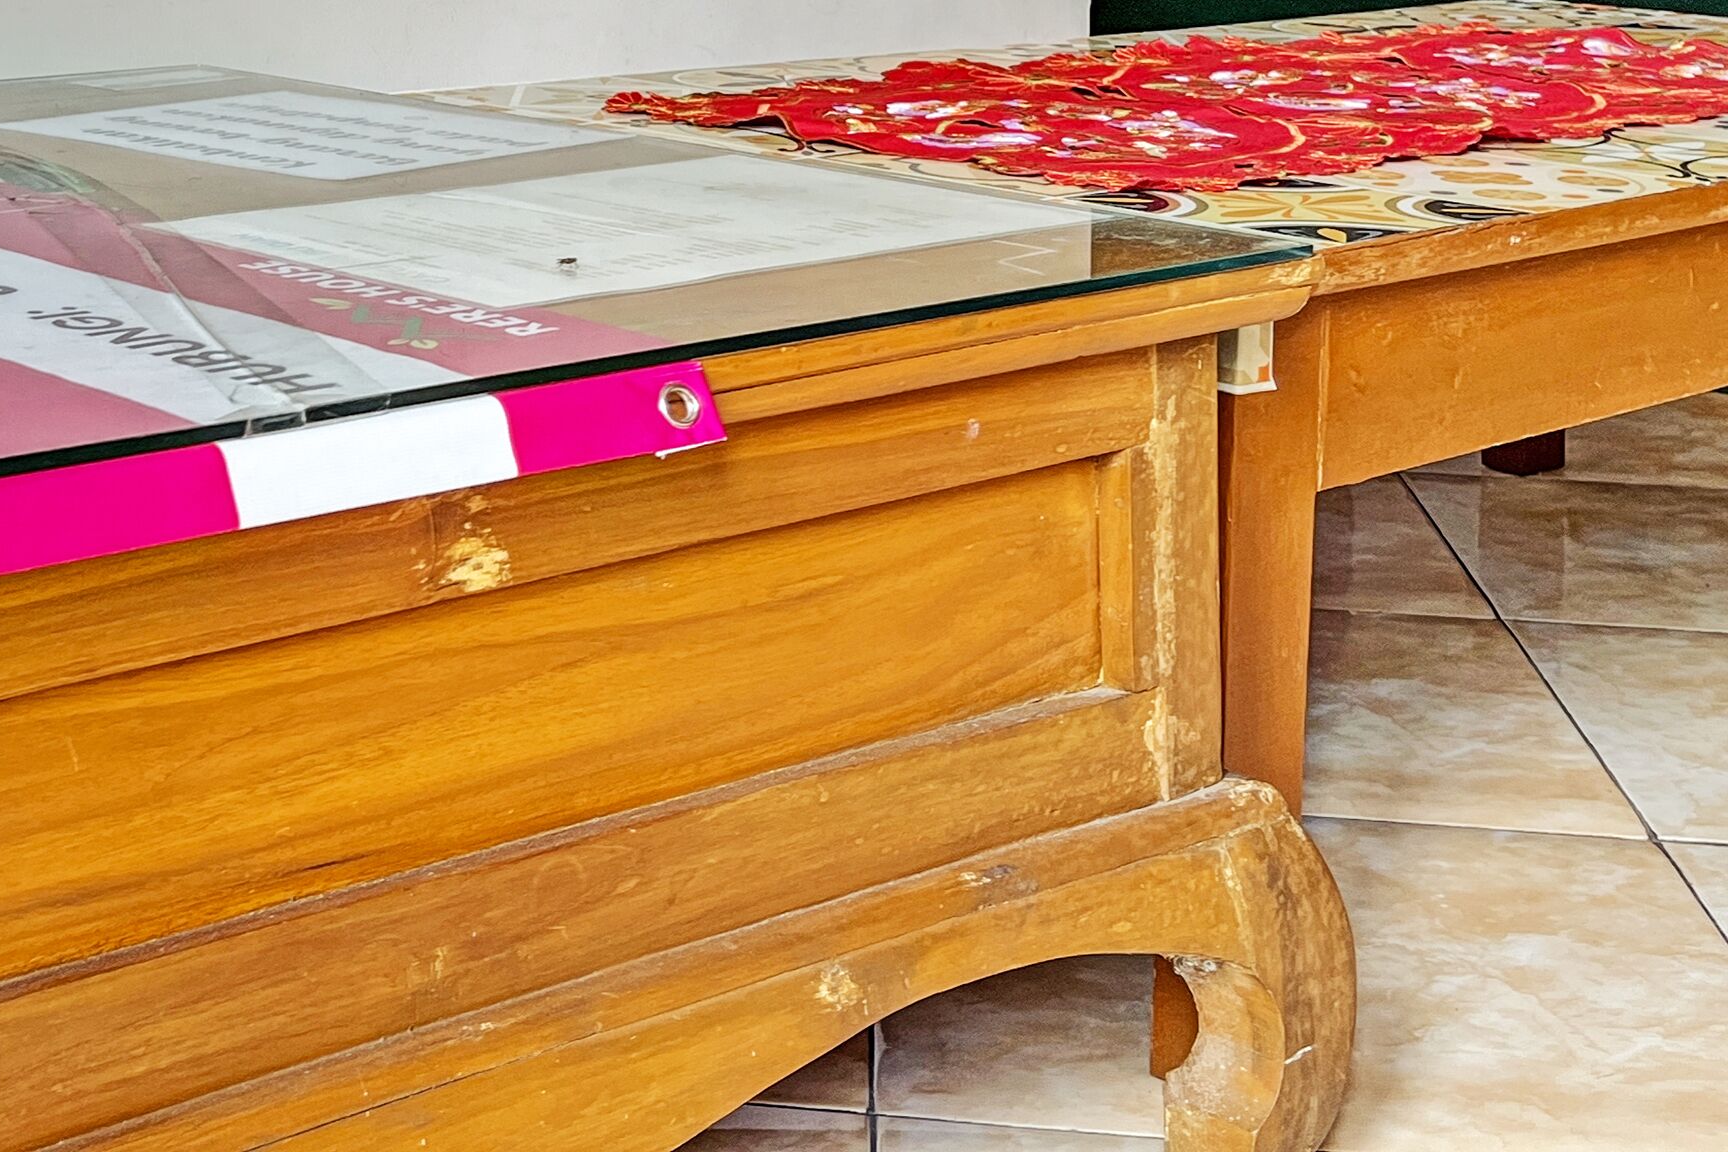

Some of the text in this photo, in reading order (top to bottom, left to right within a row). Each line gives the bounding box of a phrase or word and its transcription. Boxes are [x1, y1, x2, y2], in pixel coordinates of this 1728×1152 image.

[237, 259, 401, 298] HOUSE
[384, 295, 561, 337] RERE'S
[26, 306, 342, 395] HUBUNGI:
